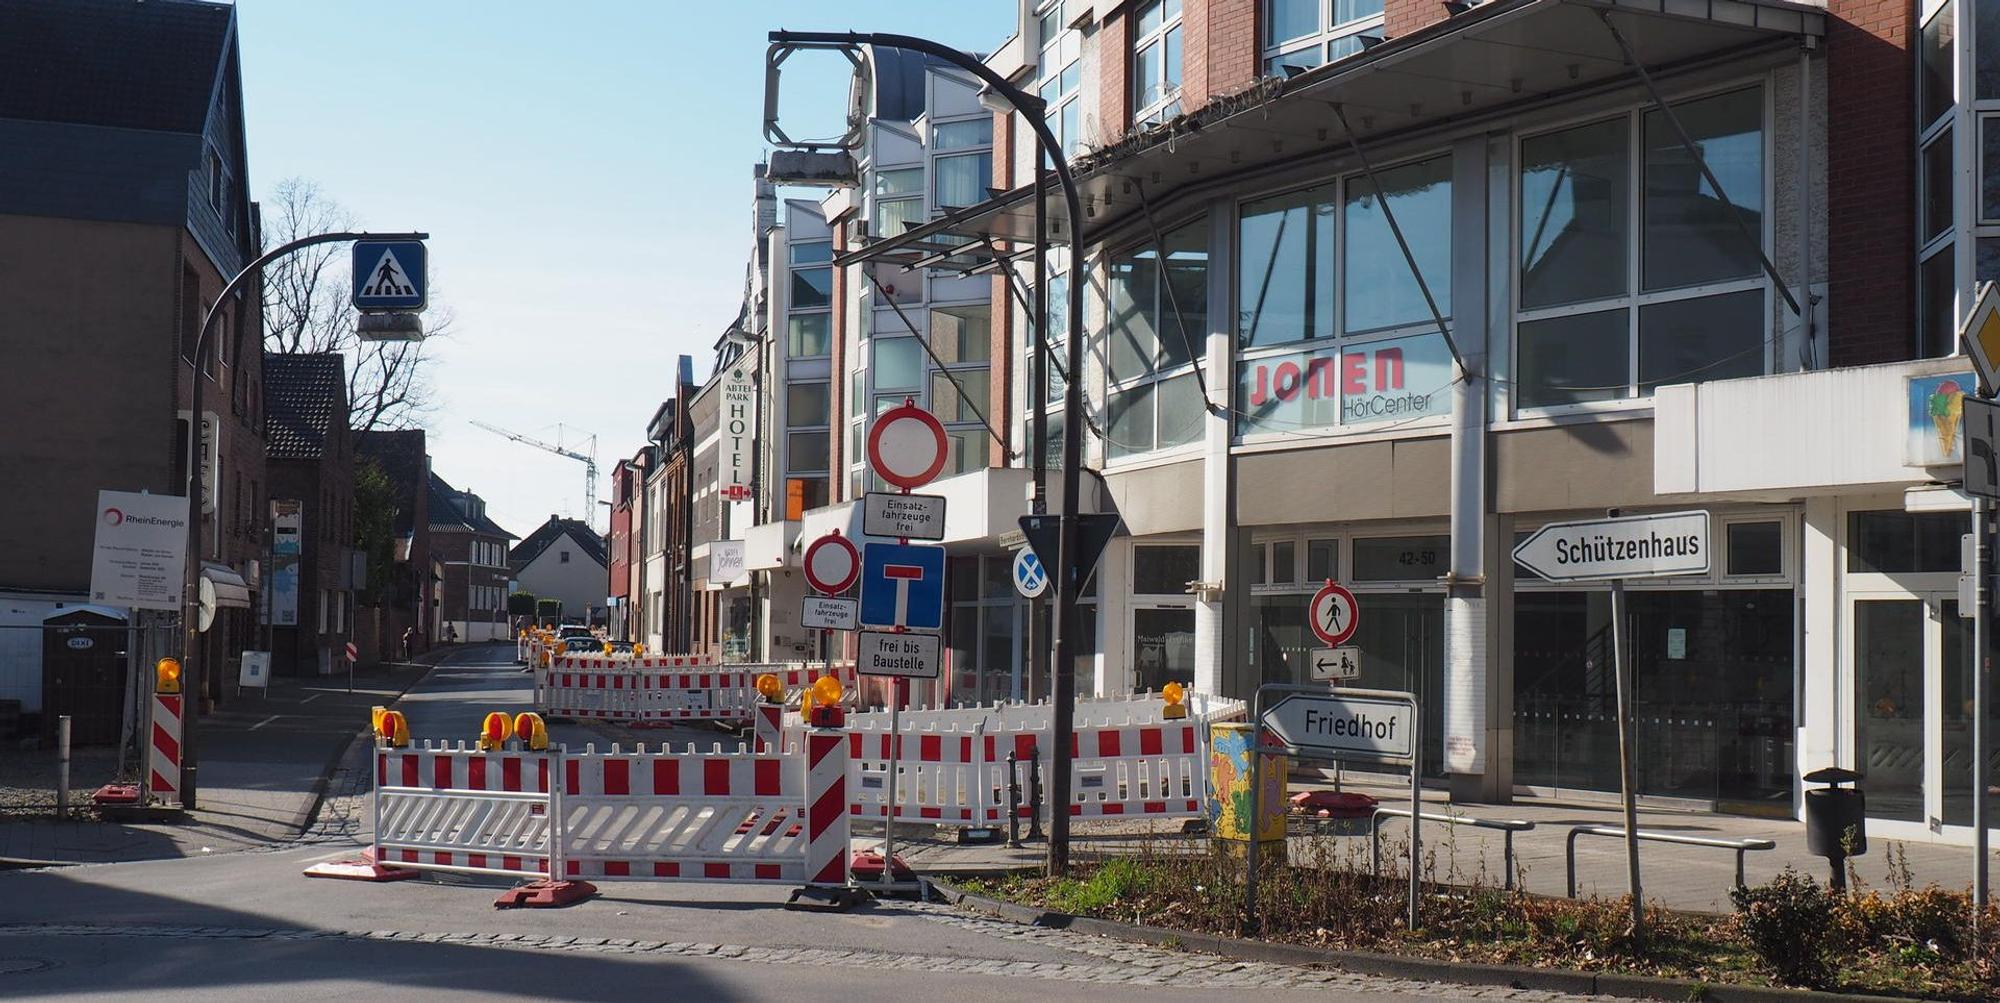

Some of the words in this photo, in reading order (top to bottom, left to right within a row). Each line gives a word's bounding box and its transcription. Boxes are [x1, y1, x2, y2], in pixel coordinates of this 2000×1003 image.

[725, 384, 751, 393] ABTEI
[726, 392, 750, 401] PARK
[1343, 392, 1432, 417] HörCenter
[729, 404, 745, 484] HOTEL
[887, 499, 928, 512] Einsatz-
[126, 514, 184, 528] RheinEnergie
[882, 509, 932, 524] fahrzeuge
[896, 521, 913, 532] frei
[1556, 531, 1699, 565] Schützenhaus
[1399, 551, 1436, 565] 42-50
[818, 601, 847, 610] Einsatz-
[814, 608, 849, 619] fahrzeuge
[824, 617, 837, 625] frei
[880, 639, 898, 653] frei
[904, 640, 920, 654] bis
[873, 654, 925, 670] Baustelle
[1305, 709, 1397, 740] Friedhof
